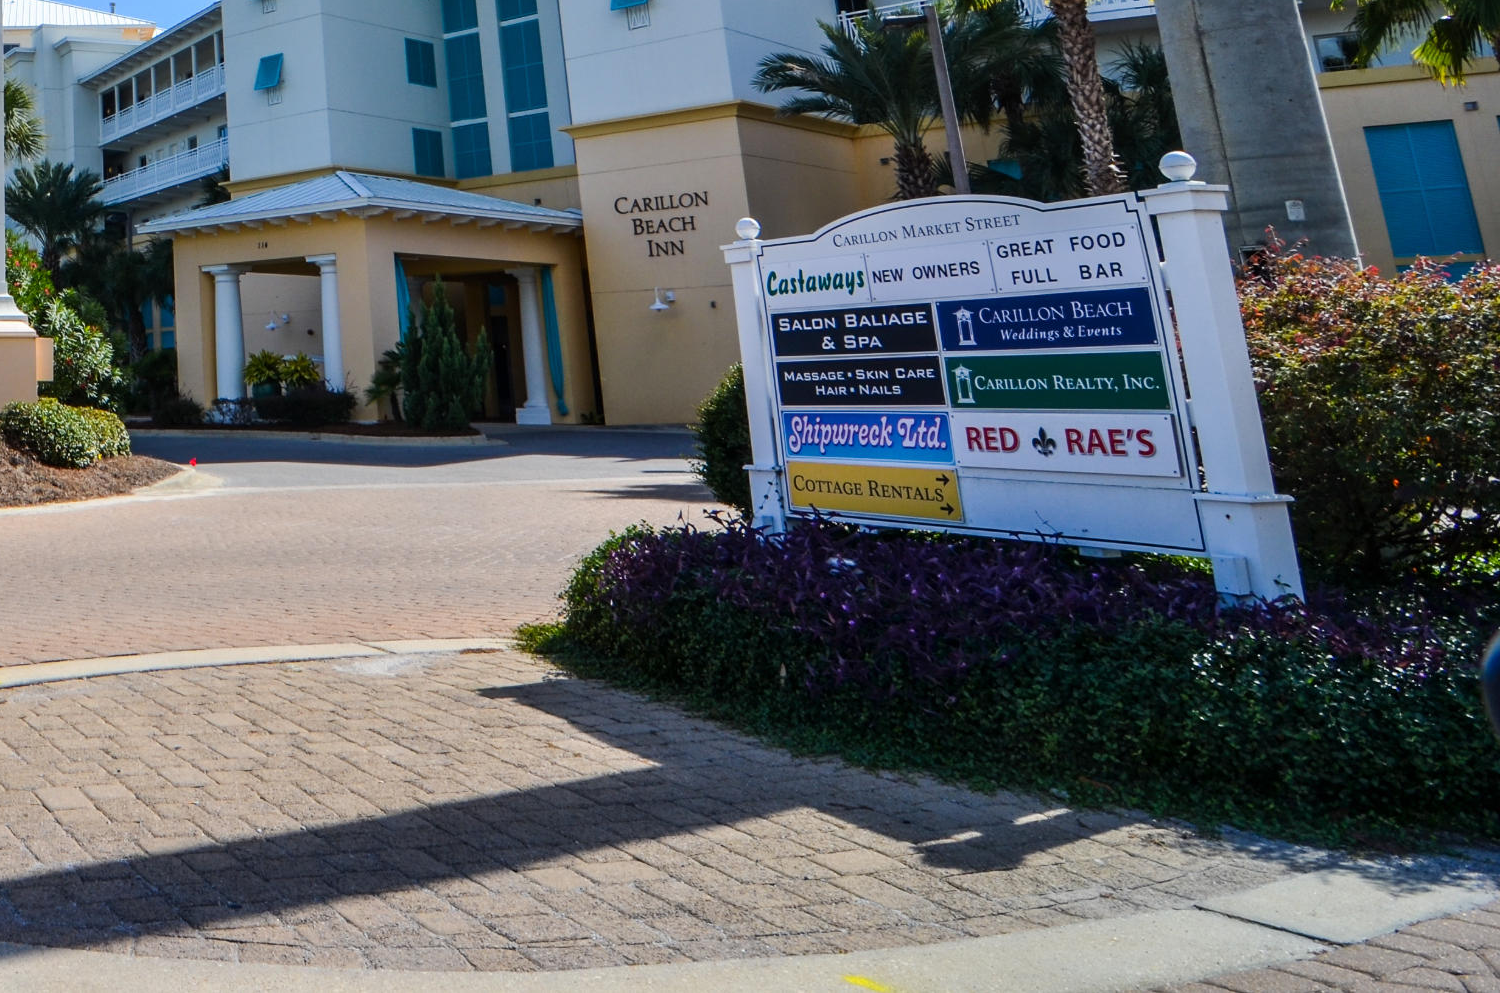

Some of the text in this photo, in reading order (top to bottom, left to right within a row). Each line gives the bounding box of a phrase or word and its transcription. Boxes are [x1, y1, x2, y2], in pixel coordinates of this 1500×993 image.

[614, 191, 708, 214] CARILLON
[631, 216, 696, 236] BEACH
[832, 214, 1021, 248] CARILLON MARKET STREET
[647, 240, 684, 257] INN
[996, 232, 1126, 259] GREAT FOOD
[766, 269, 865, 296] Castaways
[872, 261, 980, 284] NEW OWNERS
[1011, 262, 1124, 285] FULL BAR
[779, 311, 928, 332] SALON BALIAGE
[978, 301, 1133, 324] CARILLON BEACH
[821, 335, 883, 350] & SPA
[1000, 325, 1122, 341] Weddings & Events
[784, 368, 936, 382] MASSAGE SKIN CARE
[974, 374, 1160, 393] CARILLON REALTY, INC.
[815, 383, 901, 396] HAIR NAILS
[788, 415, 947, 454] Shipwreck Ltd.
[965, 426, 1156, 457] RED RAE'S
[793, 475, 944, 502] COTTAGE RENTALS
